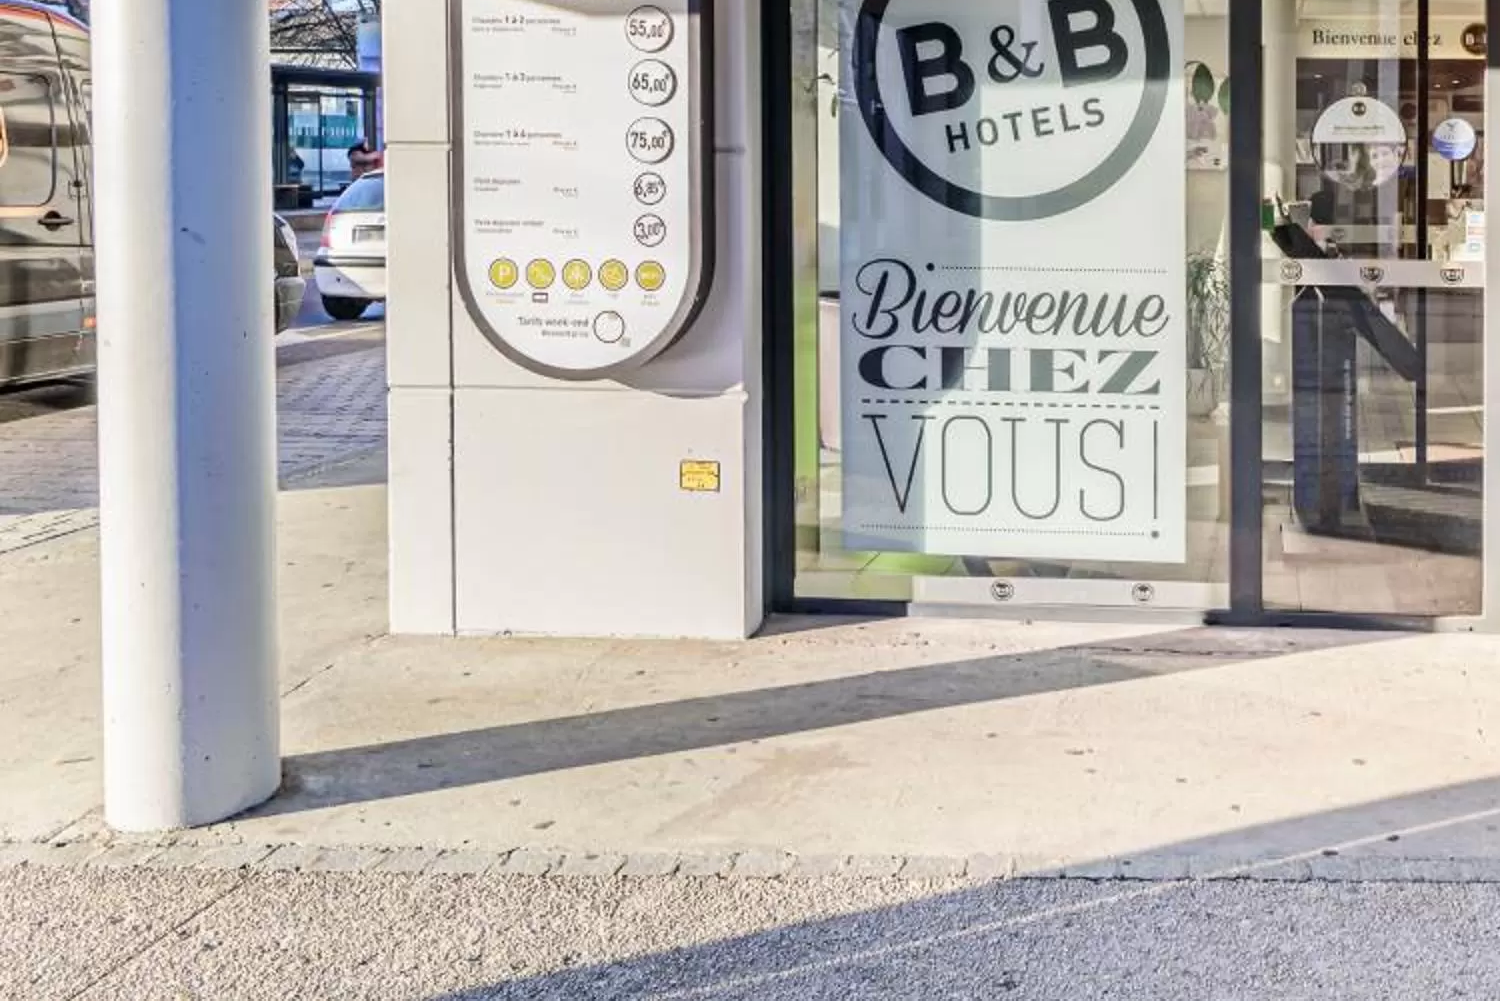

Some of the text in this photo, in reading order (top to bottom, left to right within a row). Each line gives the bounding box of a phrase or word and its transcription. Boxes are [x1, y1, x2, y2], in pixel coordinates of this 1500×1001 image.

[1312, 29, 1397, 46] Bienvenue
[945, 98, 1106, 154] HOTELS
[852, 257, 1170, 340] Bienvenue
[857, 344, 1162, 396] CHEZ
